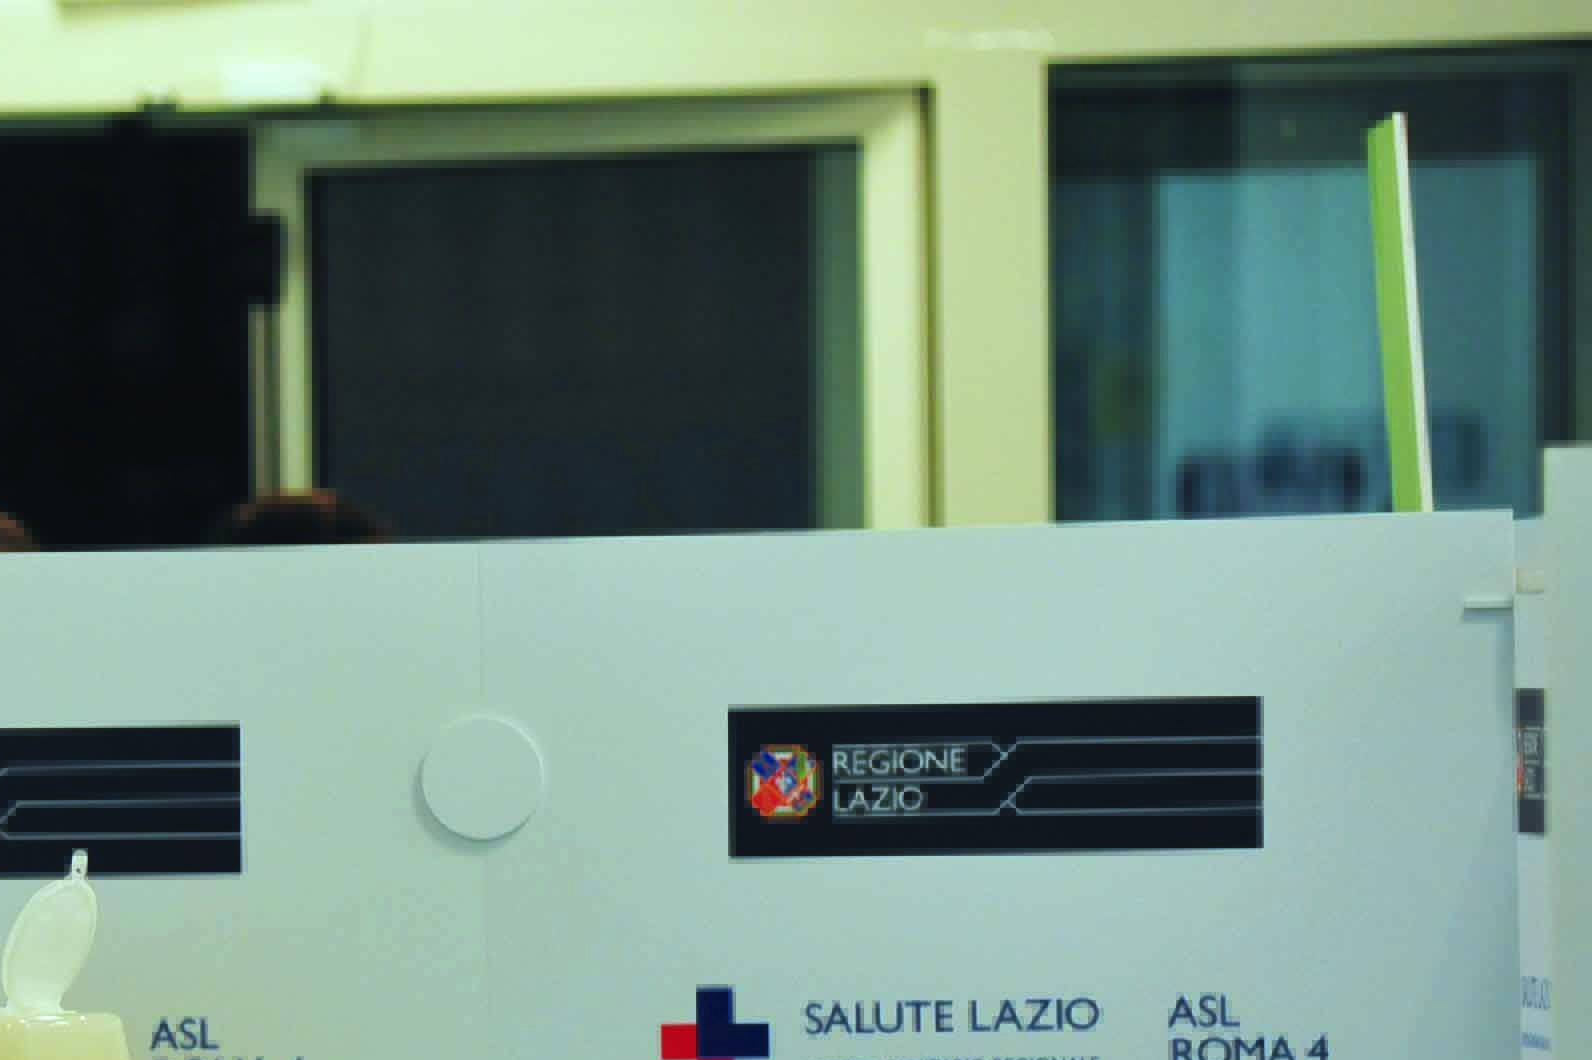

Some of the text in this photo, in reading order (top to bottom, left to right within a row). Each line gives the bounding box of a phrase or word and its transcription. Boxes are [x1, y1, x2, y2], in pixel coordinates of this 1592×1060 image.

[833, 747, 966, 775] REGIONE
[833, 784, 923, 811] LAZIO
[805, 997, 1101, 1036] SALUTE LAZIO
[1168, 994, 1241, 1028] ASL
[149, 1017, 220, 1051] ASL
